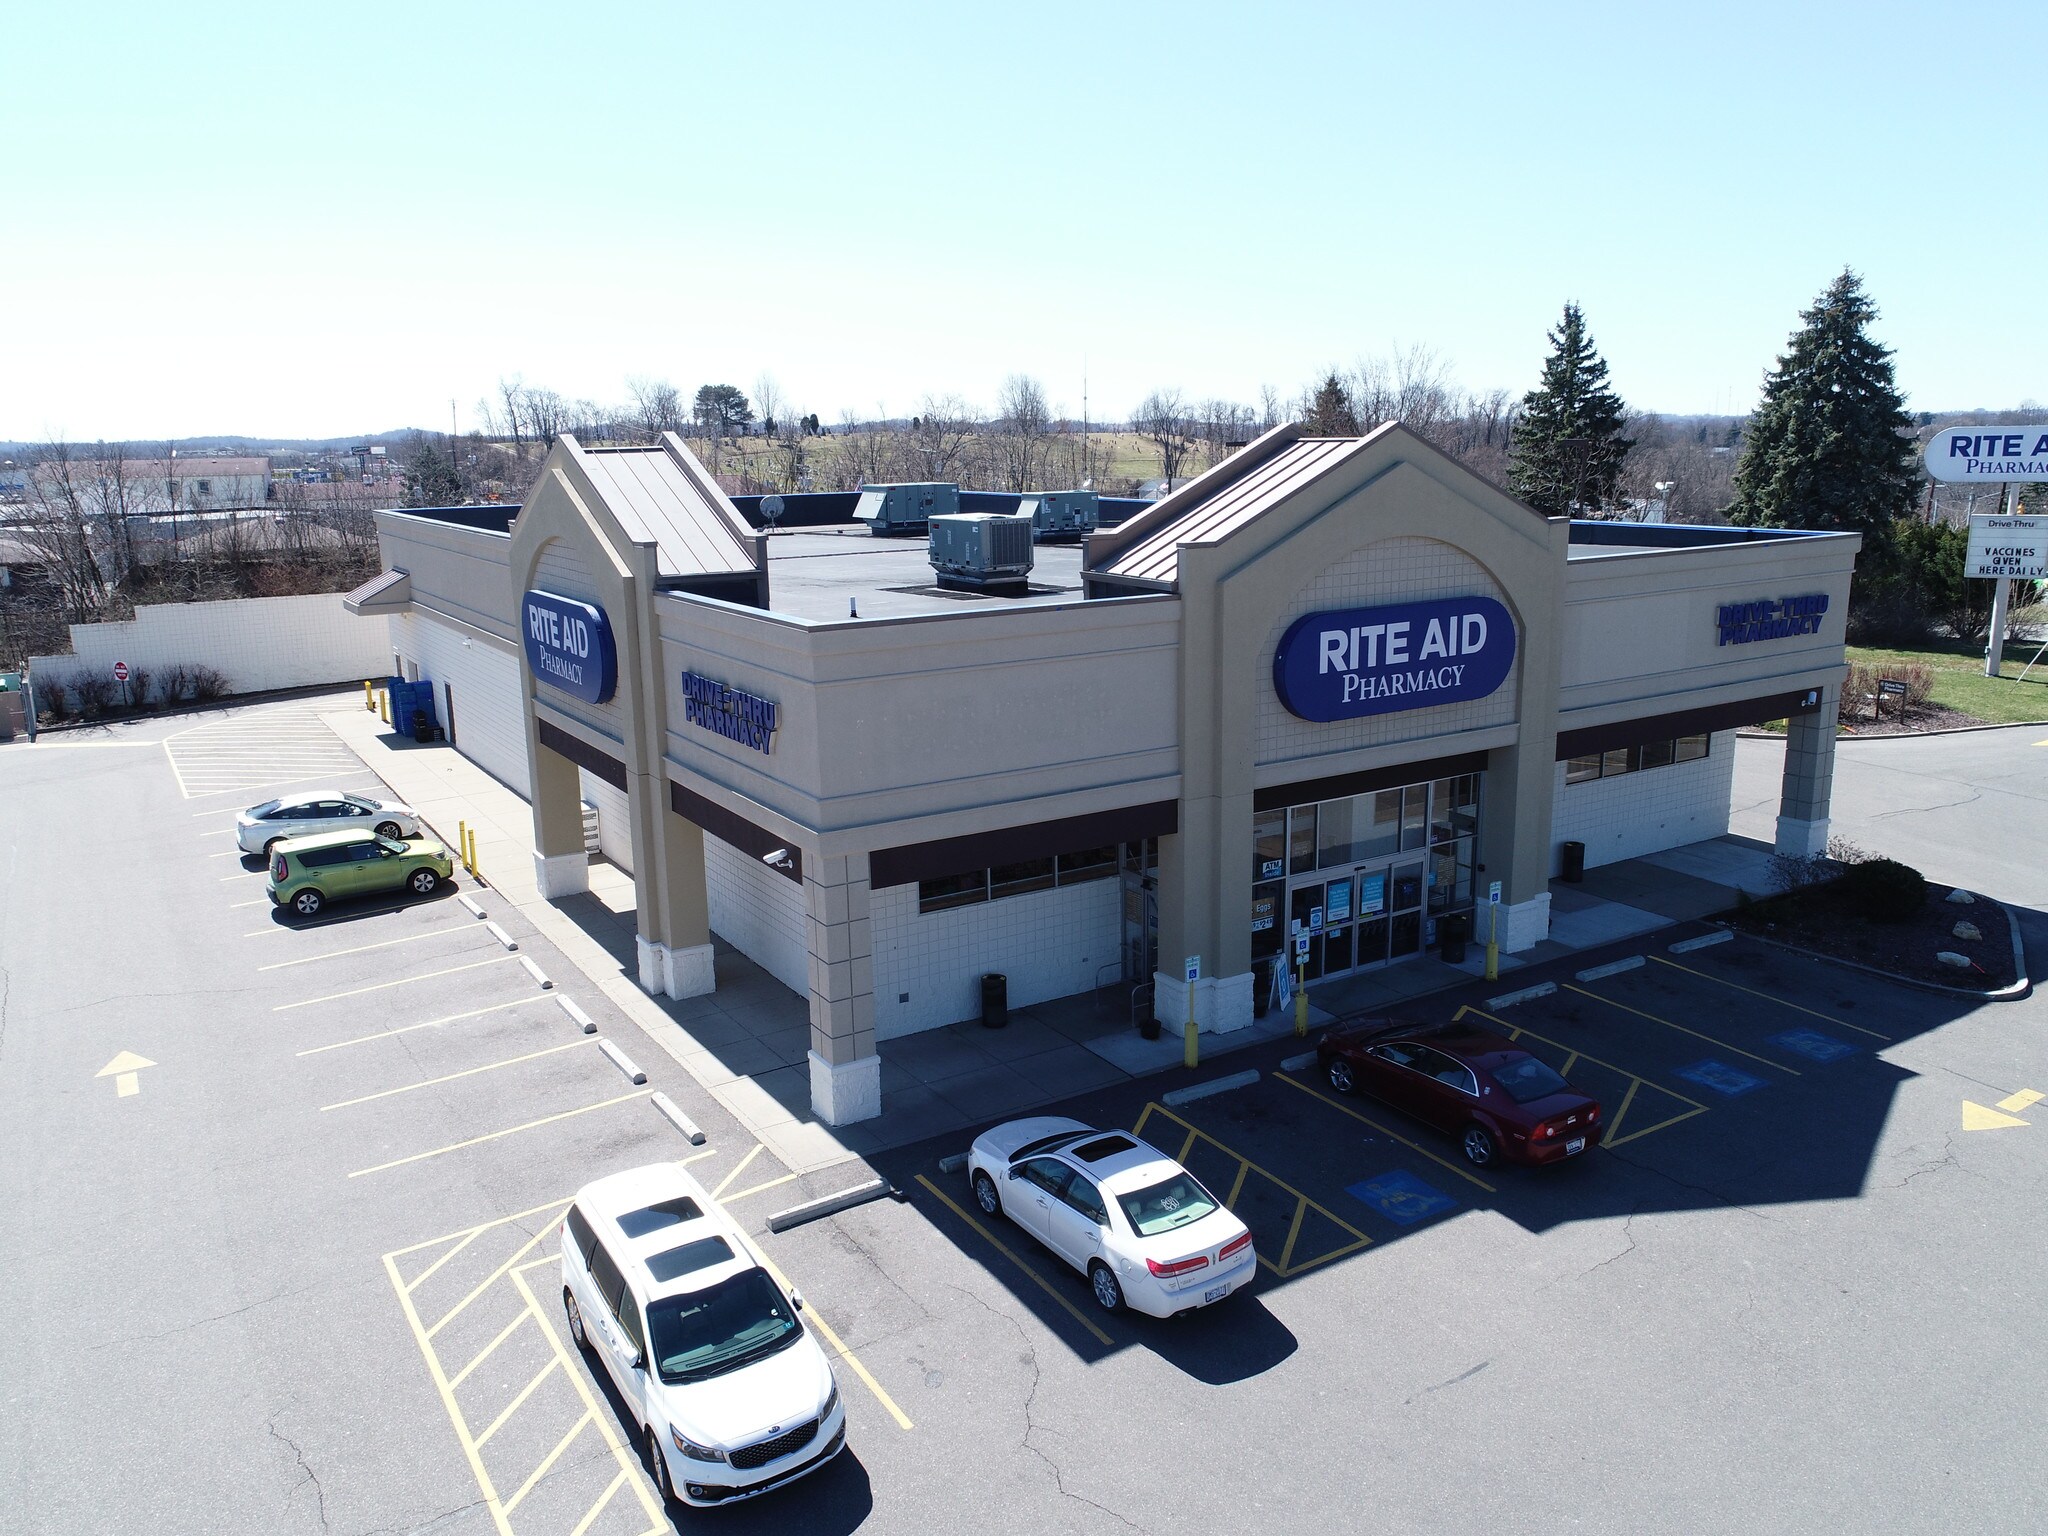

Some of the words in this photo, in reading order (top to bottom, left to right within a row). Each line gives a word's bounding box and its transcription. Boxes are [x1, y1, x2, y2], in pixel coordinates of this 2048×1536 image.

[1949, 435, 2024, 458] RITE
[1965, 459, 2048, 474] PHARMA
[1988, 519, 2012, 528] Drive
[2013, 520, 2035, 528] Thru
[1984, 547, 2036, 557] VACCINES
[1992, 557, 2021, 566] GIVEN
[1979, 566, 2005, 575] HERE
[1718, 594, 1830, 627] DRIVE-THRU
[528, 604, 561, 649] RITE
[562, 615, 589, 659] AID
[1319, 621, 1411, 675] RITE
[1418, 612, 1488, 661] AID
[1719, 615, 1824, 647] PHARMACY
[539, 644, 584, 686] PHARMACY
[1341, 664, 1466, 704] PHARMACY
[681, 670, 778, 730] DRIVE-THRU
[684, 697, 775, 756] PHARMACY
[1265, 860, 1280, 871] ATM
[1256, 903, 1271, 913] Eggs
